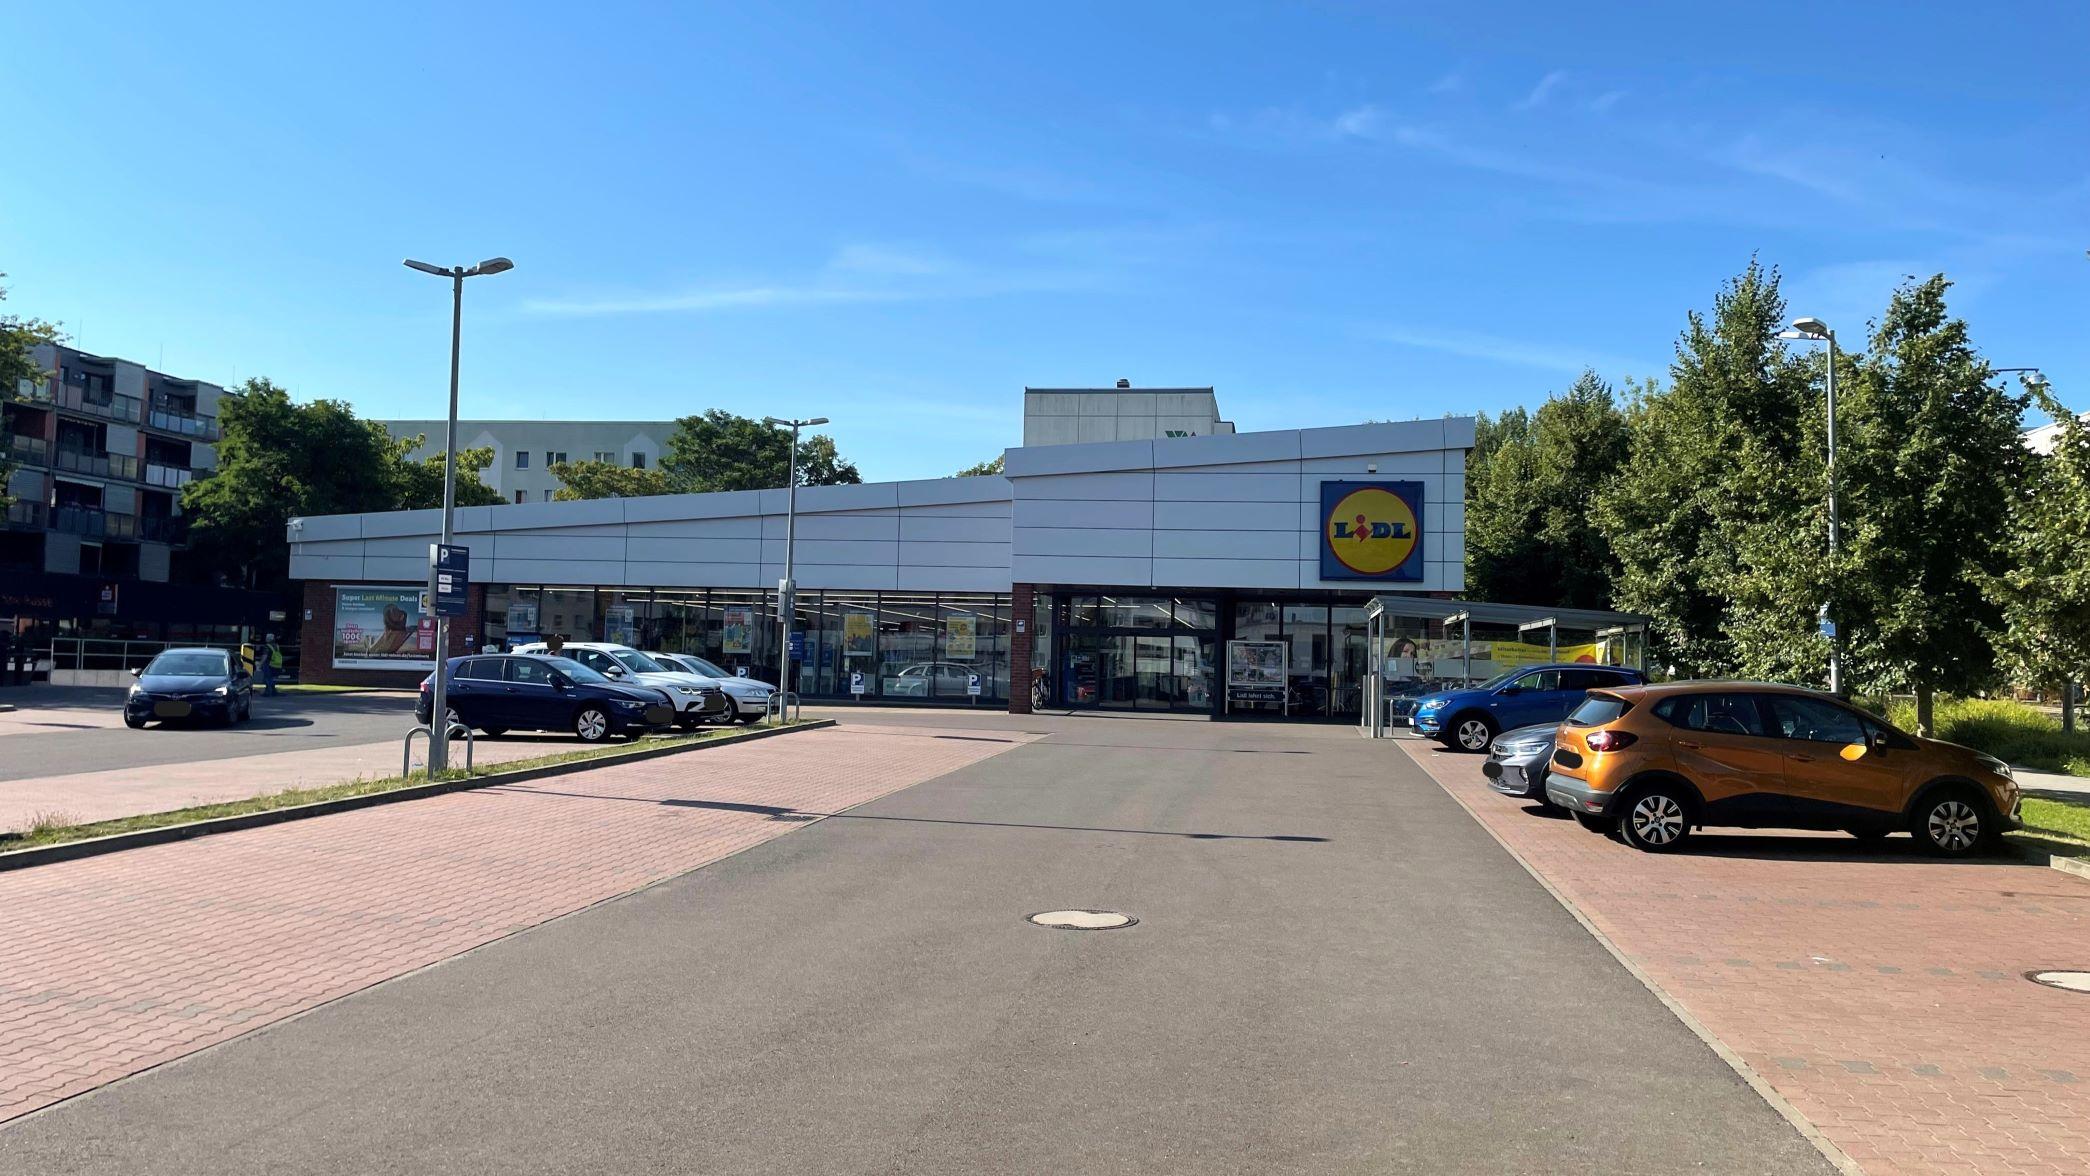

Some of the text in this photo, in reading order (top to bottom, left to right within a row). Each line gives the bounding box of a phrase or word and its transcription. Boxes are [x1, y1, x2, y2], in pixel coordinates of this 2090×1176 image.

[440, 548, 449, 562] P
[341, 594, 360, 602] Super
[738, 668, 746, 678] P
[853, 673, 861, 685] P
[969, 675, 978, 686] P
